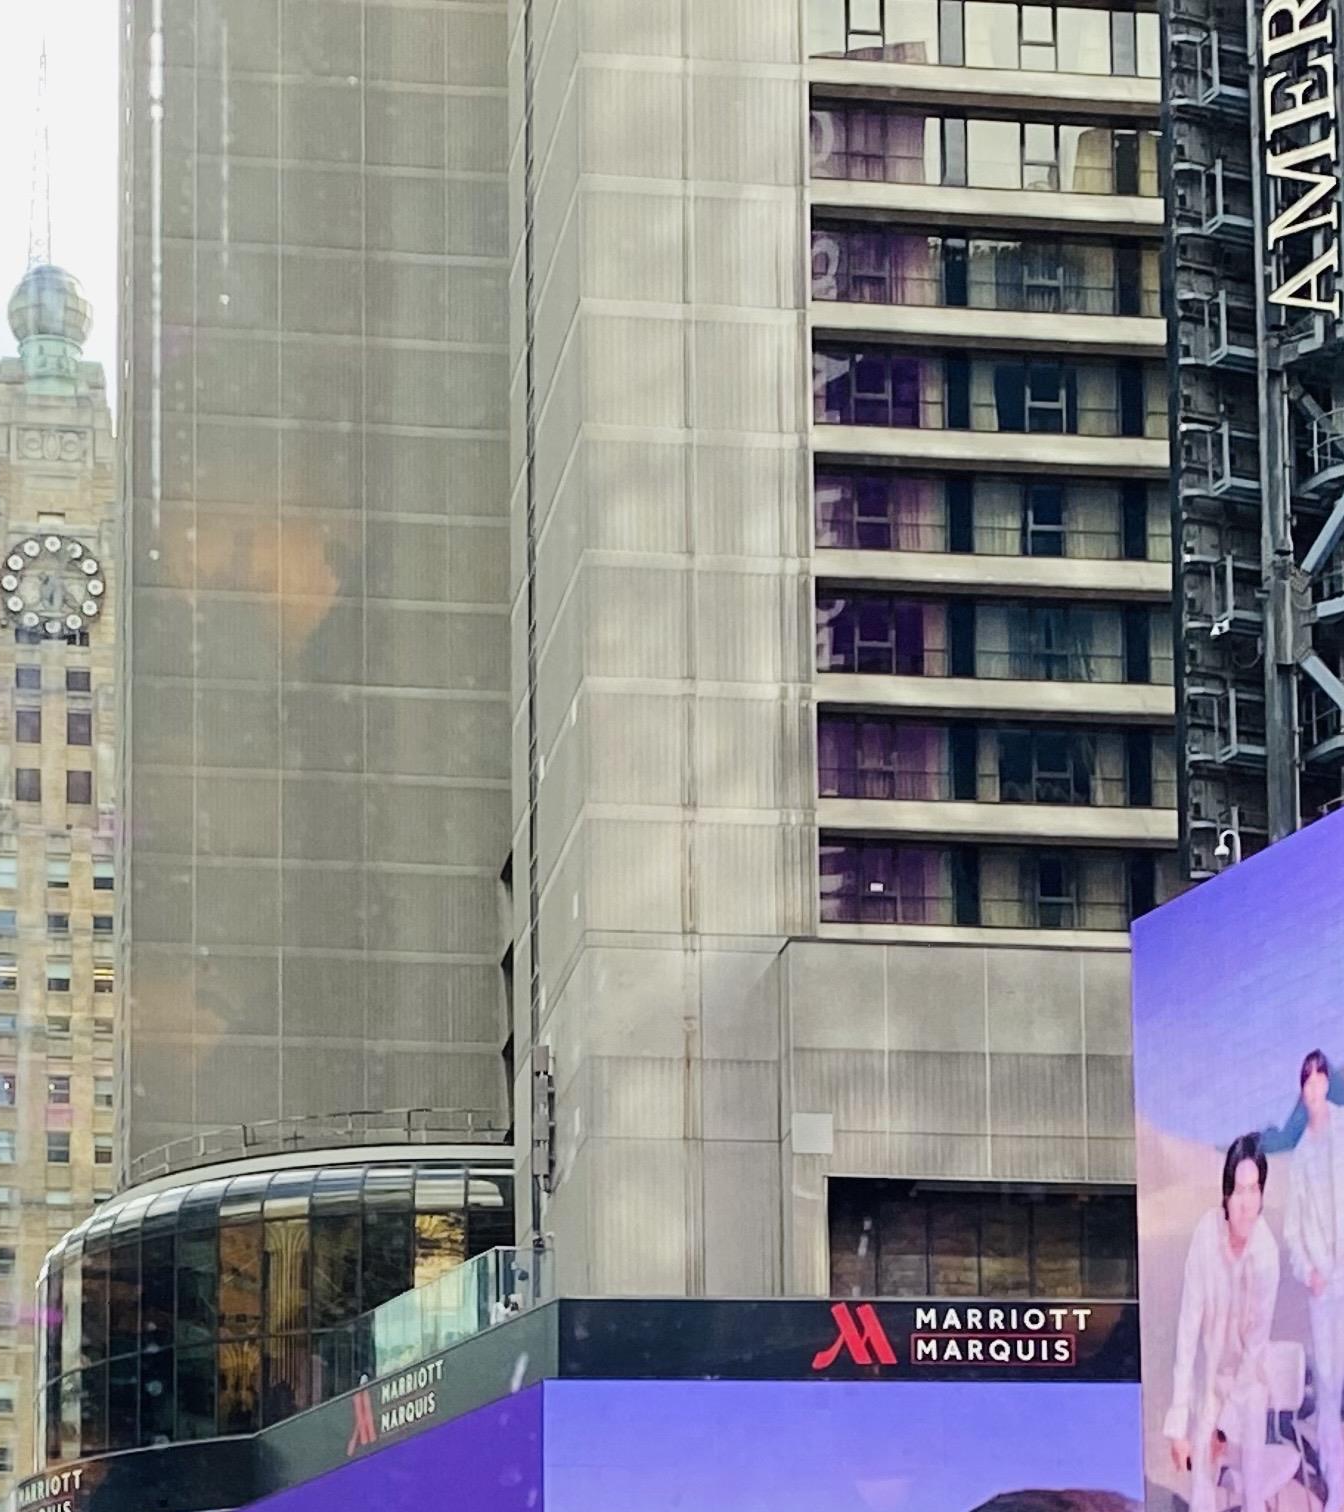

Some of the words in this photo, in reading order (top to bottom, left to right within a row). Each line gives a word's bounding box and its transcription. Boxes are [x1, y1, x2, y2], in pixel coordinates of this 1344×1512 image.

[915, 1307, 1092, 1331] MARRIOTT
[916, 1338, 1071, 1362] MARQUIS
[381, 1359, 444, 1404] MARRIOTT
[381, 1391, 436, 1432] MARQUIS
